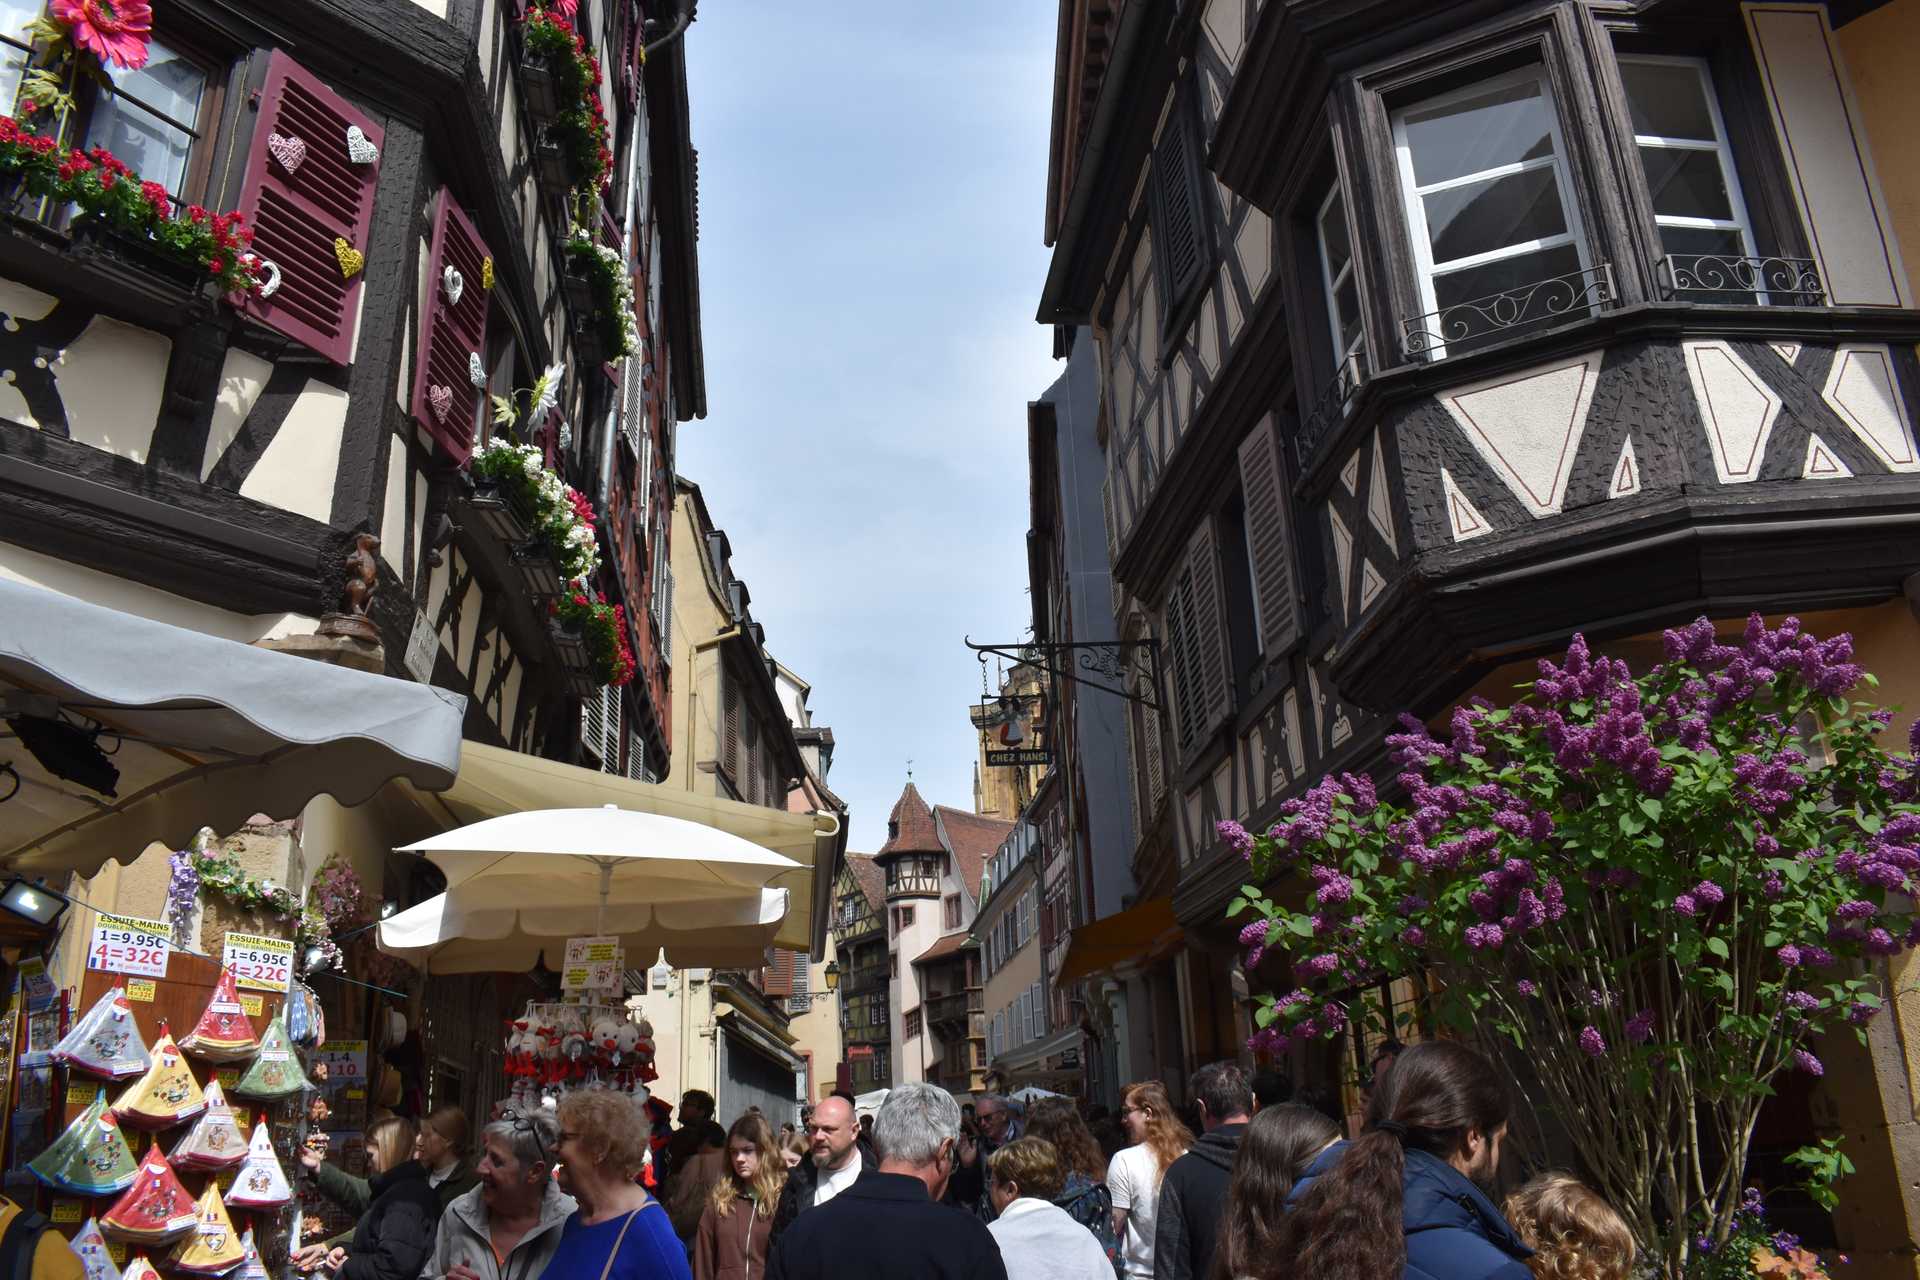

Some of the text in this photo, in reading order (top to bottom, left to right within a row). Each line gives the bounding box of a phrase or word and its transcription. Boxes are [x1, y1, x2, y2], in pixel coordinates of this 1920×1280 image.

[990, 752, 1048, 763] CHEZ HANSI
[100, 914, 169, 931] ESSUIE-MAINS
[229, 934, 292, 950] ESSUIE-MAINS
[95, 944, 164, 966] 4=32€
[228, 962, 287, 982] 4=22€
